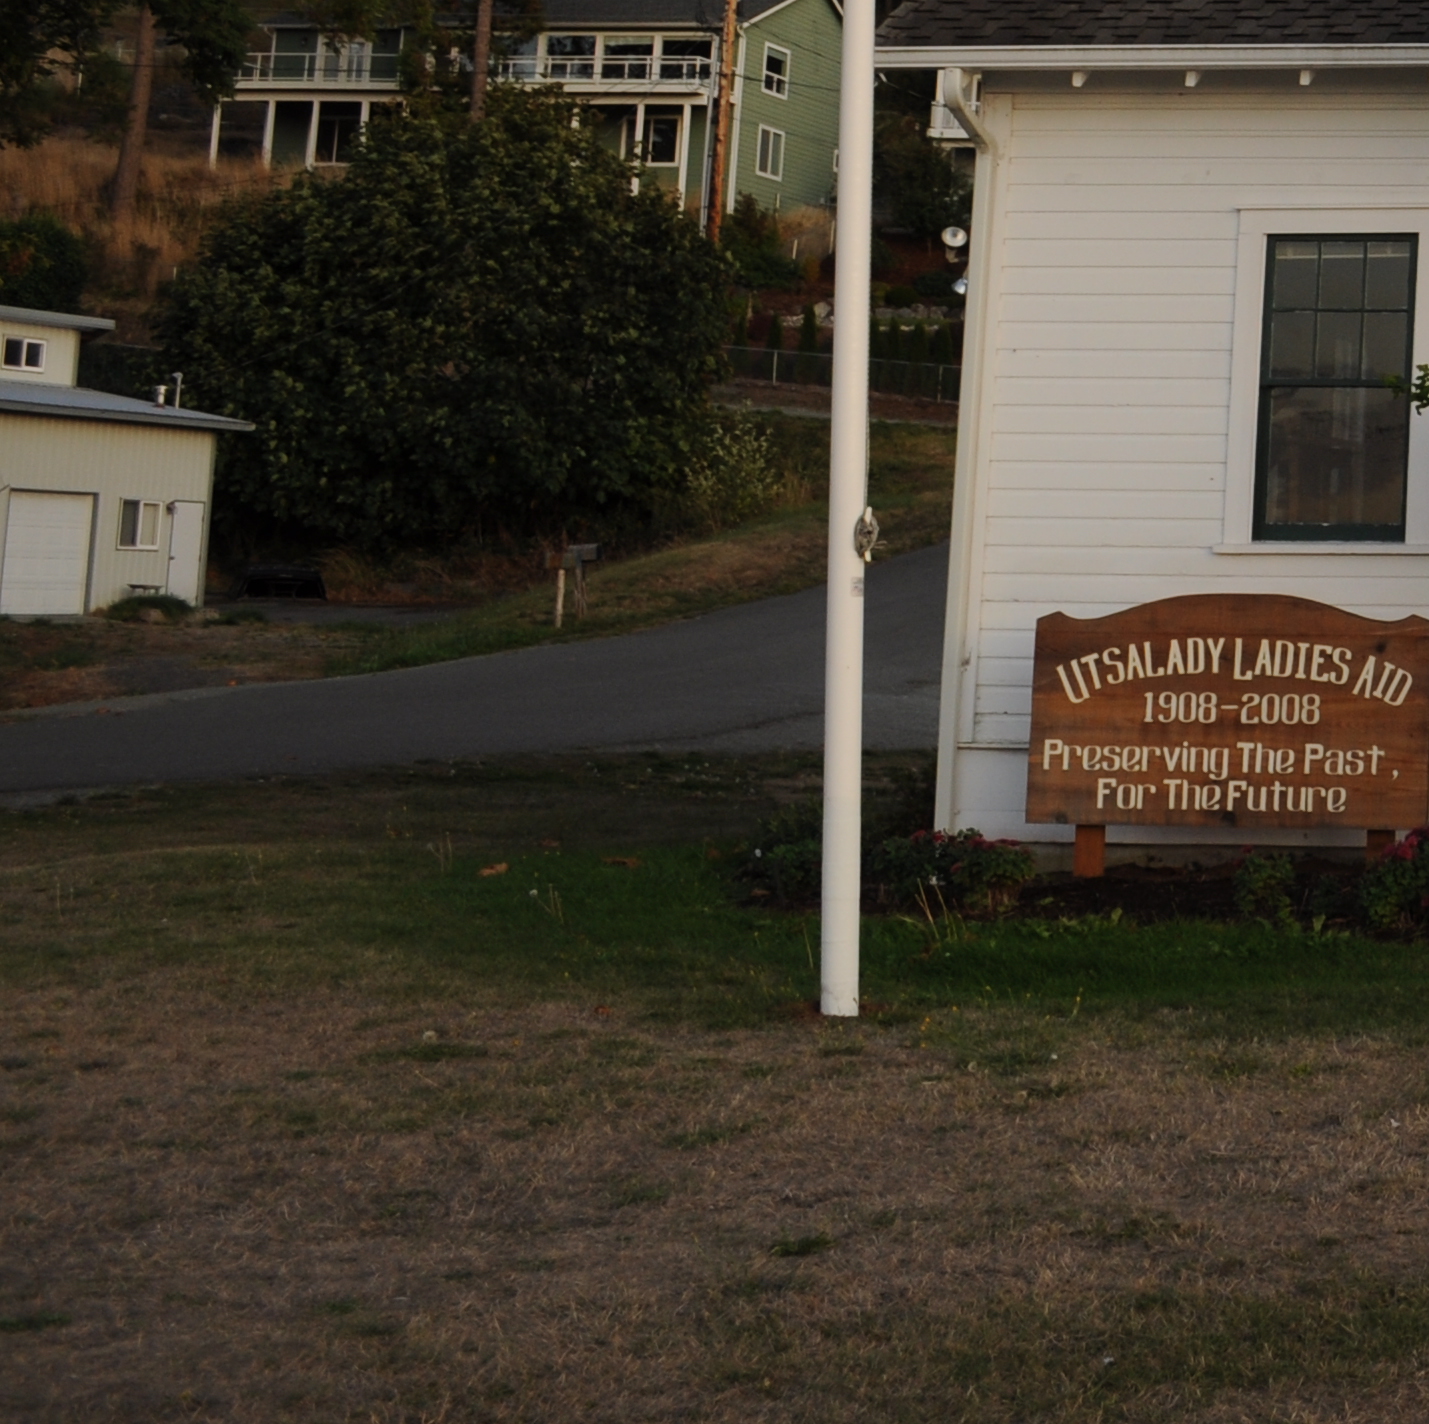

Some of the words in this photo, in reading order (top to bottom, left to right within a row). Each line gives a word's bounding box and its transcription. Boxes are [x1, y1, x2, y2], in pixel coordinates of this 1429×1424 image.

[1056, 637, 1226, 704] UTSALADY
[1232, 637, 1352, 686] LADIES
[1351, 655, 1413, 707] AID
[1143, 690, 1321, 726] 1908-2008
[1042, 738, 1229, 781] Preserving
[1236, 741, 1295, 775] The
[1096, 777, 1156, 811] For
[1163, 777, 1221, 811] The
[1226, 779, 1347, 813] Future
